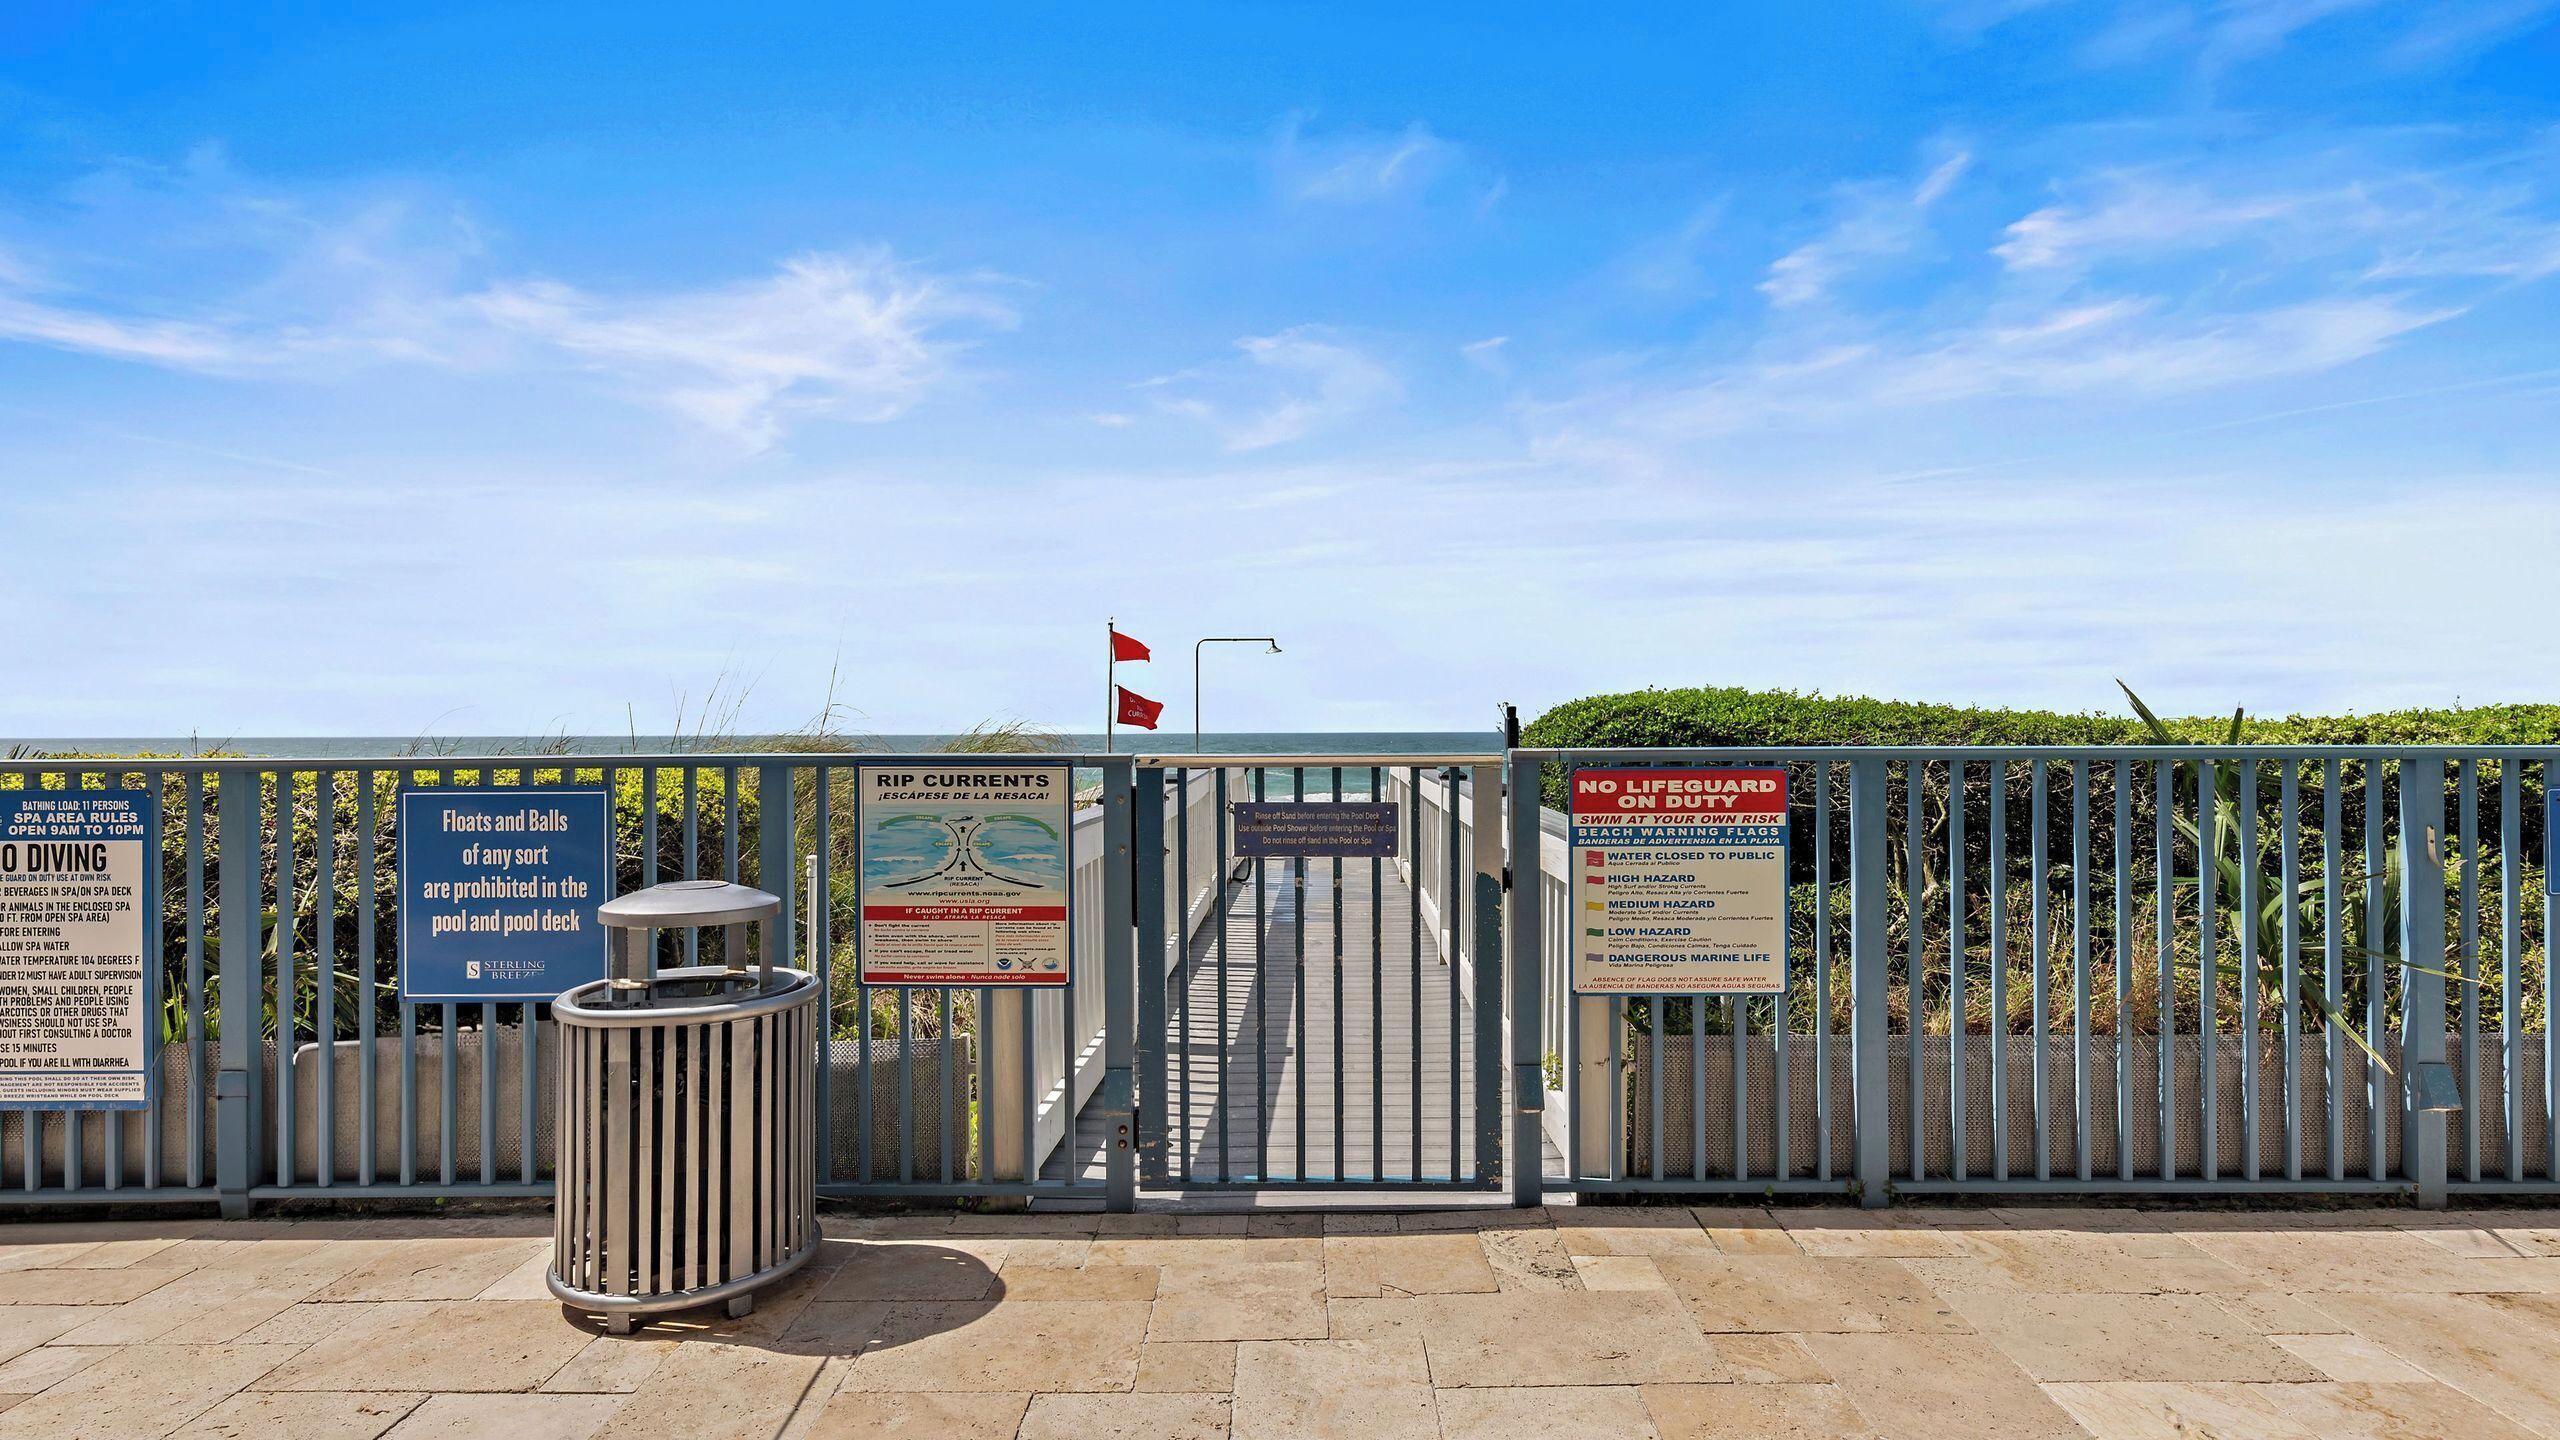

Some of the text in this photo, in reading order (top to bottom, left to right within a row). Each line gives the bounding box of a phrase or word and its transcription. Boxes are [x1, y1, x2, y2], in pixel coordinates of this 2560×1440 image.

[878, 775, 1049, 787] RIP CURRENTS
[1579, 780, 1776, 793] NO LIFEGUARD
[23, 801, 129, 811] BATHING LOAD: 11 PERSONS
[1618, 795, 1738, 808] ON DUTY
[15, 813, 42, 823] SPA
[46, 813, 85, 823] AREA
[91, 813, 137, 823] RULES
[443, 809, 568, 832] Floats and Balls
[1580, 815, 1778, 824] SWIM AT YOUR OWN RISK
[8, 825, 143, 835] OPEN 9AM TO 10PM
[1579, 828, 1778, 836] BEACH WARNING FLAGS
[2, 844, 106, 872] O DIVING
[463, 843, 548, 870] of any sort
[1608, 852, 1774, 860] WATER CLOSED TO PUBLIC
[5, 887, 131, 897] BEVERAGES IN SPA/ON SPA DECK
[424, 876, 587, 903] are prohibited in the
[9, 902, 43, 911] ANIMALS
[46, 902, 53, 911] IN
[57, 902, 70, 911] THE
[73, 902, 112, 911] ENCLOSED
[116, 902, 130, 911] SPA
[7, 913, 109, 923] FT. FROM OPEN SPA AREA)
[432, 909, 580, 937] pool and pool deck
[0, 928, 60, 936] FORE ENTERING
[26, 942, 41, 951] SPA
[44, 942, 69, 951] WATER
[0, 956, 139, 965] ATER TEMPERATURE 104 DEGREES F
[1609, 954, 1770, 962] DANGEROUS MARINE LIFE
[13, 1044, 20, 1053] 15
[23, 1044, 57, 1053] MINUTES
[20, 1058, 26, 1067] IF
[28, 1058, 41, 1067] YOU
[44, 1058, 58, 1067] ARE
[60, 1058, 70, 1067] ILL
[72, 1058, 90, 1067] WITH
[93, 1058, 129, 1067] DIARRHEA
